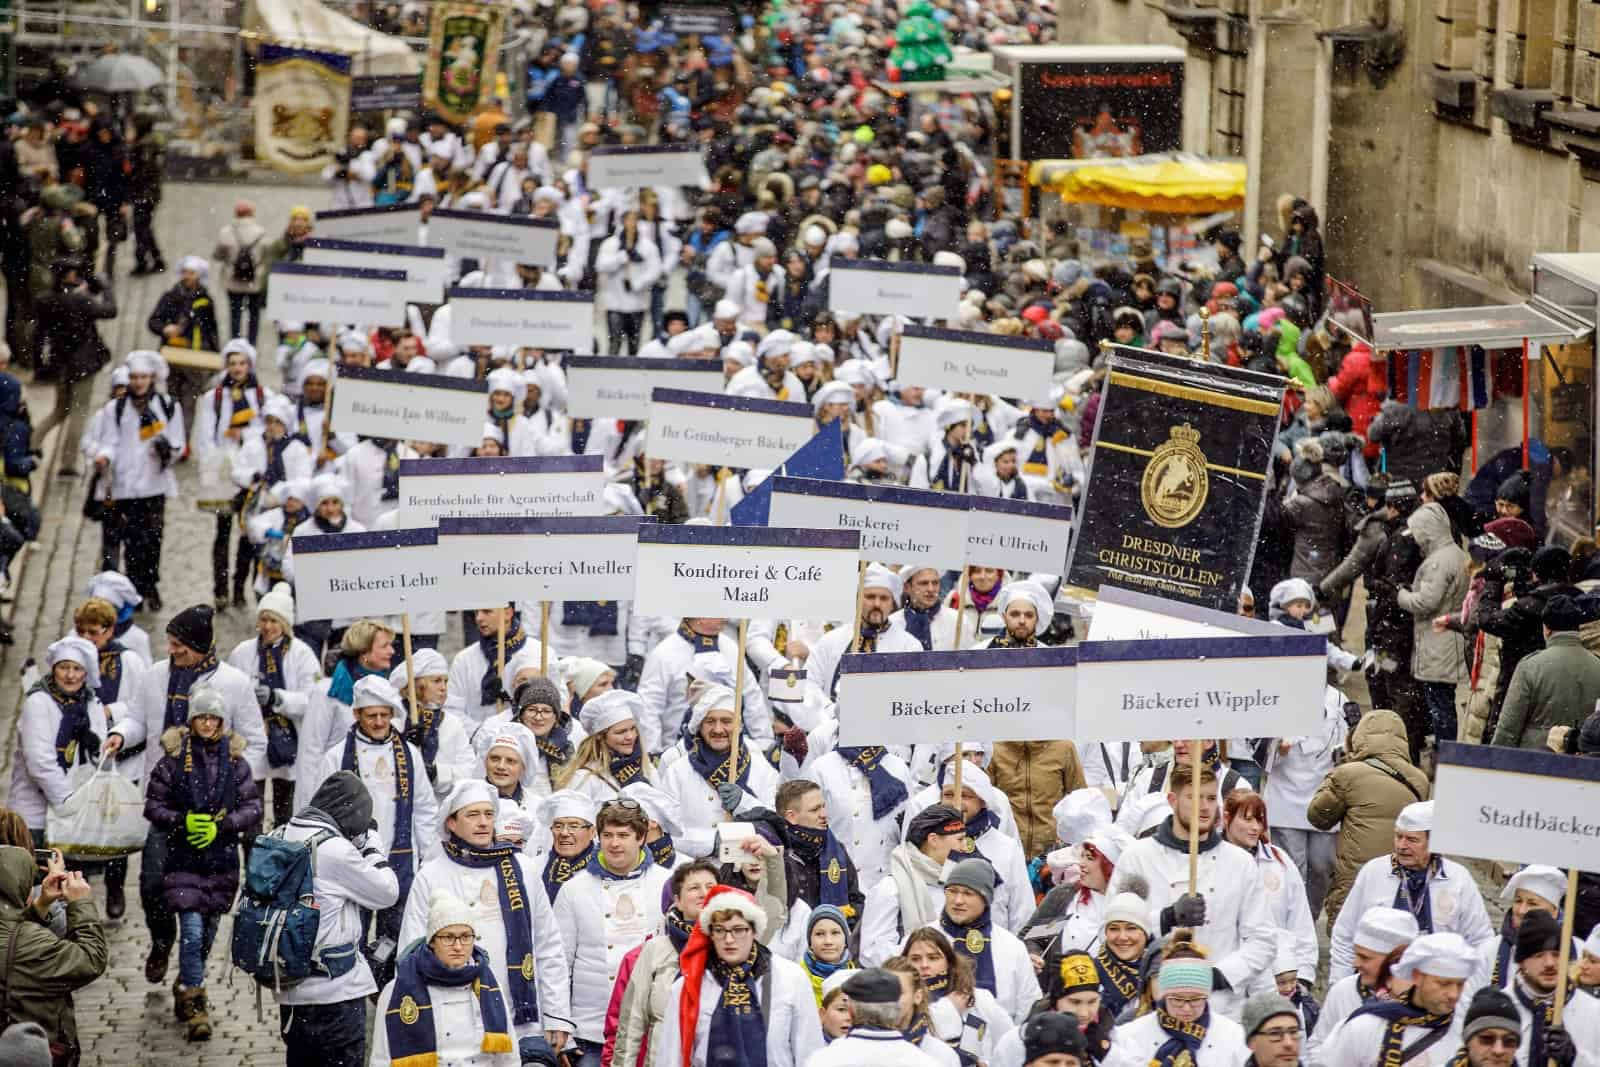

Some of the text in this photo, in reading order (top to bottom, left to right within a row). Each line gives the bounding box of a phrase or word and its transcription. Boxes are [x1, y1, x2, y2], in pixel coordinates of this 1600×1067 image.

[965, 362, 1008, 381] Quendt
[351, 400, 467, 425] Bäckerei Jan Willner
[661, 425, 680, 440] Ihr
[683, 427, 752, 449] Grünberger
[408, 490, 596, 507] Berufsschule für Agrarwirtschaft
[838, 512, 900, 531] Bäckerei
[861, 534, 932, 554] Liebscher
[1000, 535, 1049, 553] Ullrich
[1122, 534, 1201, 564] DRESDNER
[462, 559, 633, 577] Feinbäckerei Mueller
[673, 561, 823, 582] Konditorei & Café
[329, 575, 395, 593] Bäckerei
[722, 586, 769, 603] Maaß
[891, 697, 1032, 717] Bäckerei Scholz
[1121, 689, 1281, 712] Bäckerei Wippler
